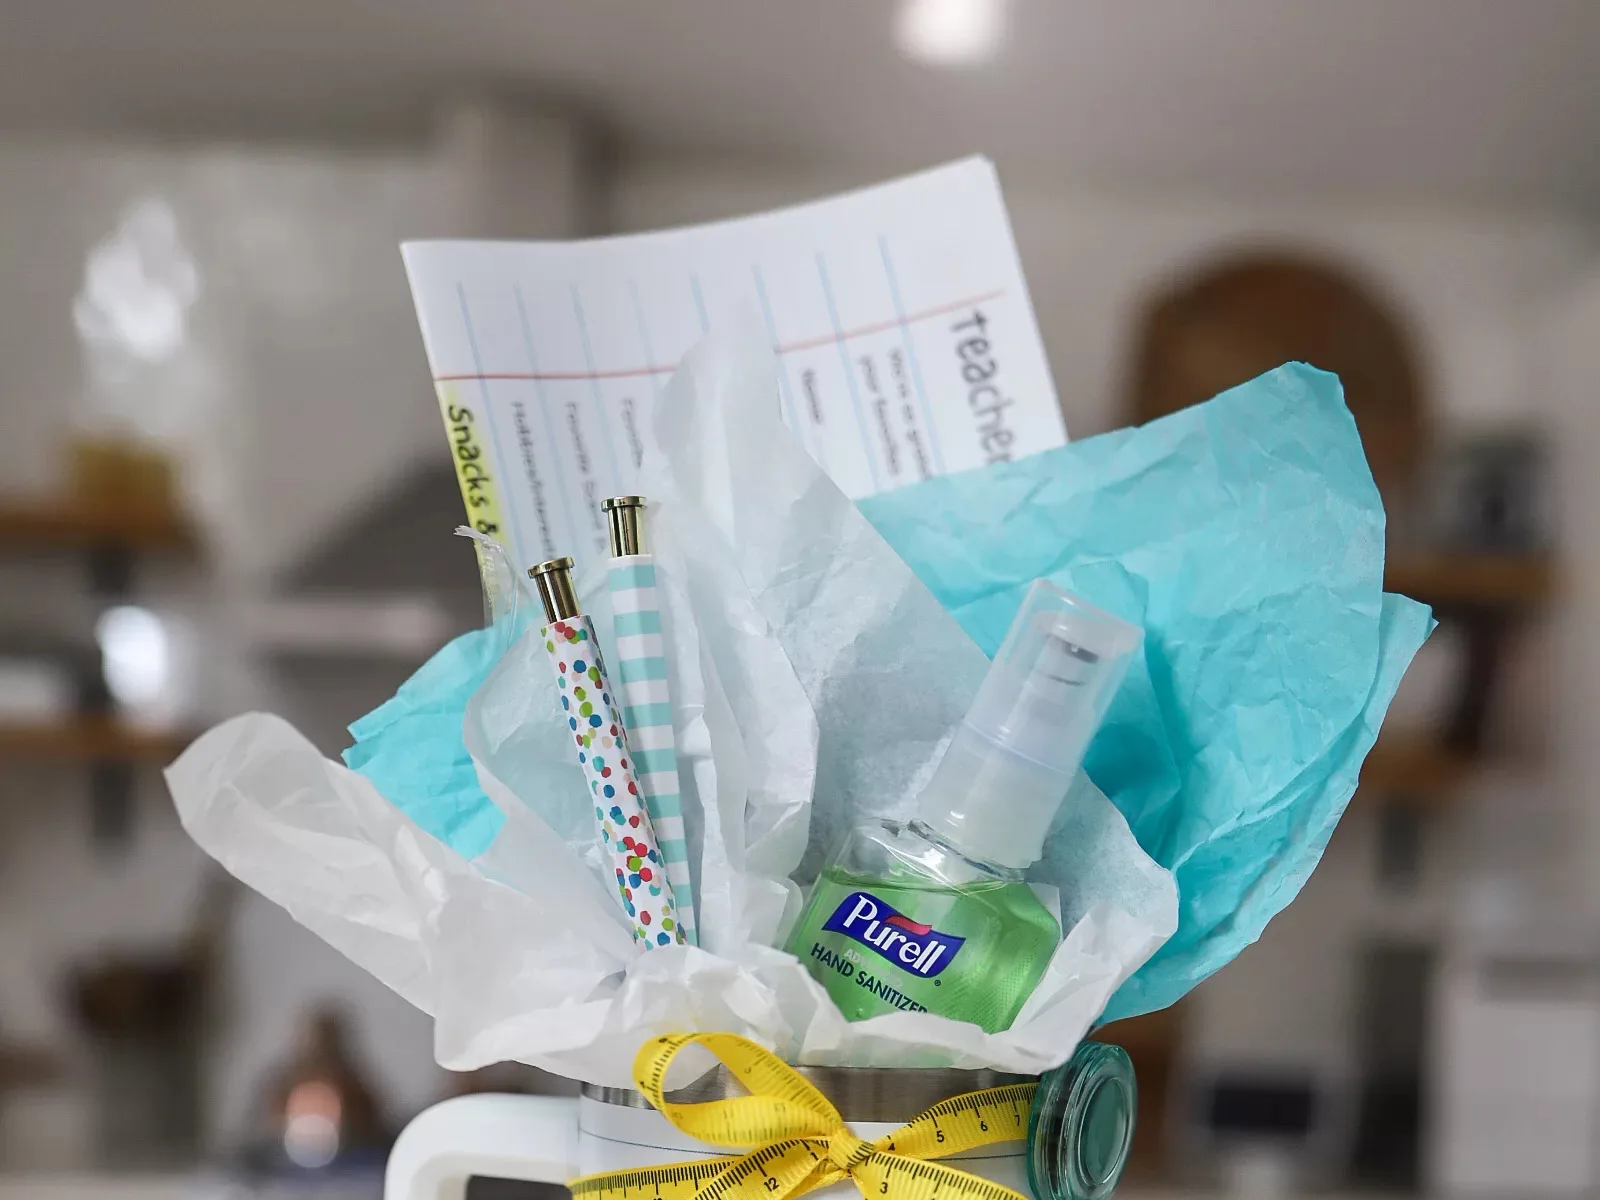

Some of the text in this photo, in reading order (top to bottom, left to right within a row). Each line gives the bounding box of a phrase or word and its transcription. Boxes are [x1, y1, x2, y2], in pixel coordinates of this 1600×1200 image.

[448, 404, 490, 509] Snacks
[842, 894, 948, 975] Purell
[810, 942, 855, 978] HAND
[936, 1130, 944, 1142] 5
[980, 1120, 988, 1132] 6
[1014, 1114, 1020, 1126] 7
[763, 1177, 780, 1192] 12
[880, 1182, 888, 1194] 3
